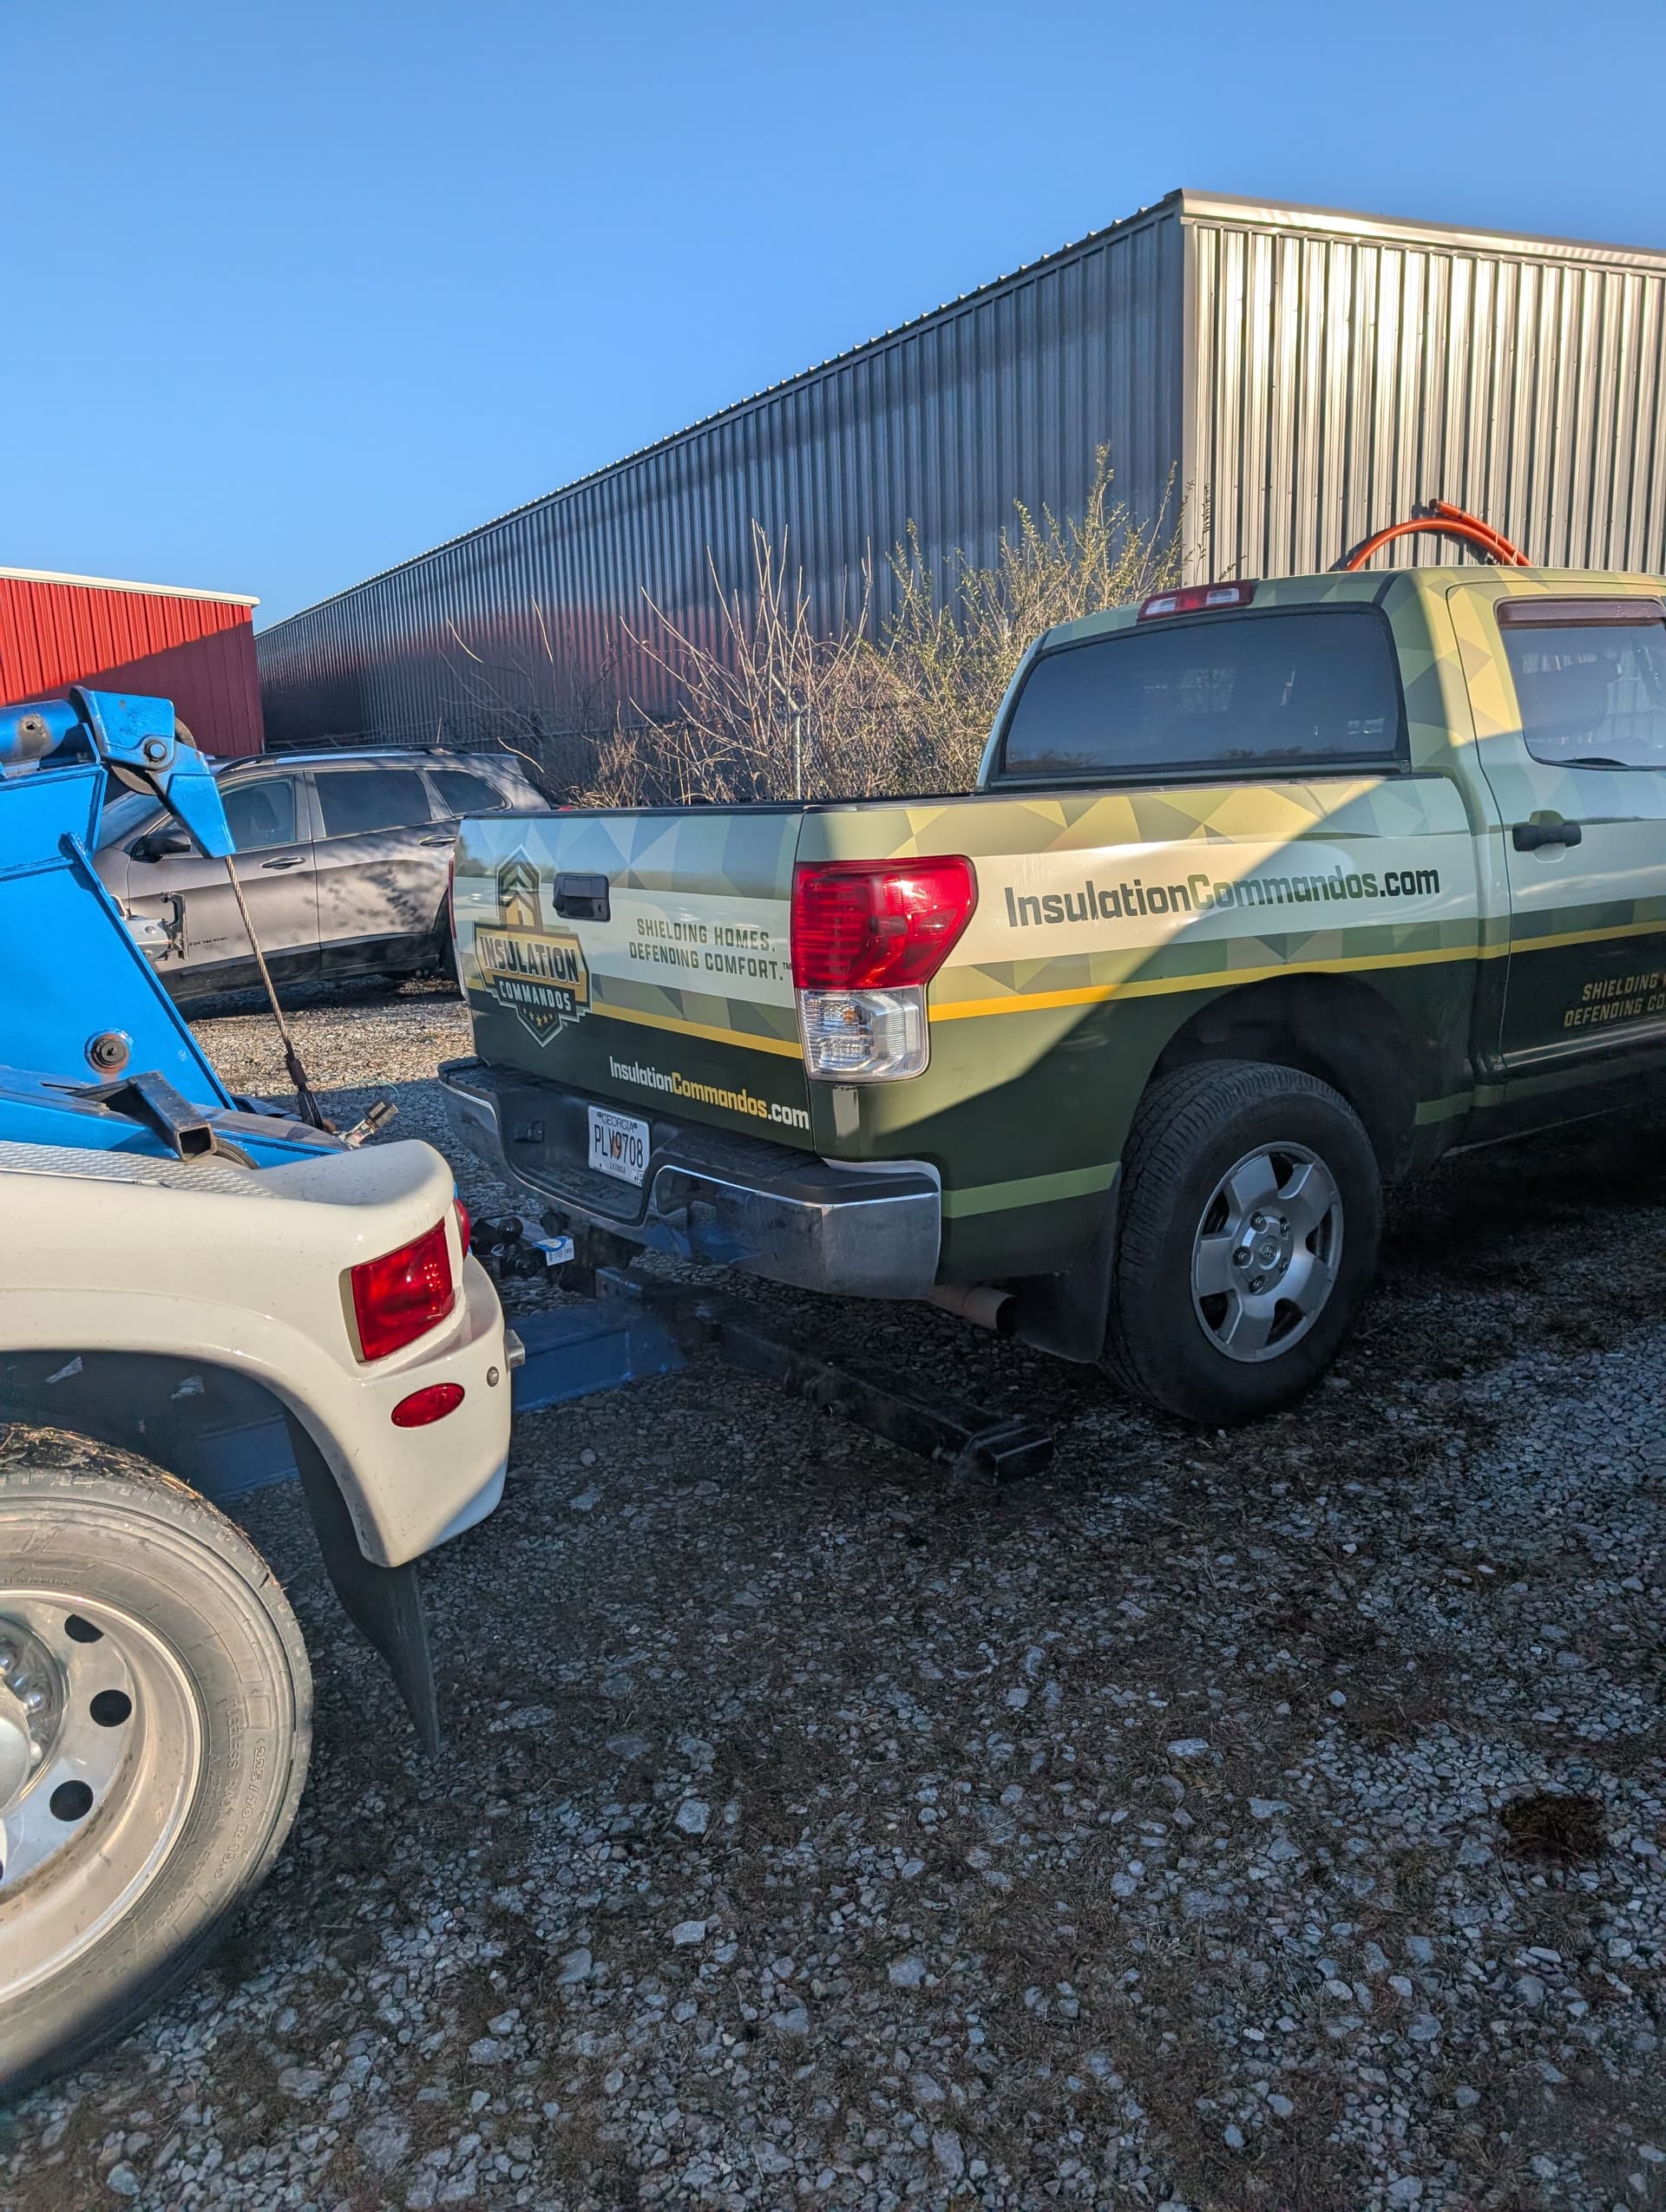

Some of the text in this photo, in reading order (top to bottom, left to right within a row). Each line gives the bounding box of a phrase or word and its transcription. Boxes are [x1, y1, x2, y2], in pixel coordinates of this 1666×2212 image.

[1004, 864, 1440, 928] InsulationCommandos.com
[637, 918, 776, 952] SHIELDING HOMES.
[479, 935, 581, 985] INSULATION
[629, 941, 699, 969] DEFENDING
[499, 980, 572, 1011] COMMANDOS
[1582, 972, 1659, 1001] SHIELDING
[1564, 992, 1666, 1028] DEFENDING CO
[609, 1056, 810, 1130] InsulationCommandos.com
[601, 1113, 634, 1133] GEORGIA
[594, 1124, 643, 1168] PLV9708
[242, 1746, 266, 1819] 225/70
